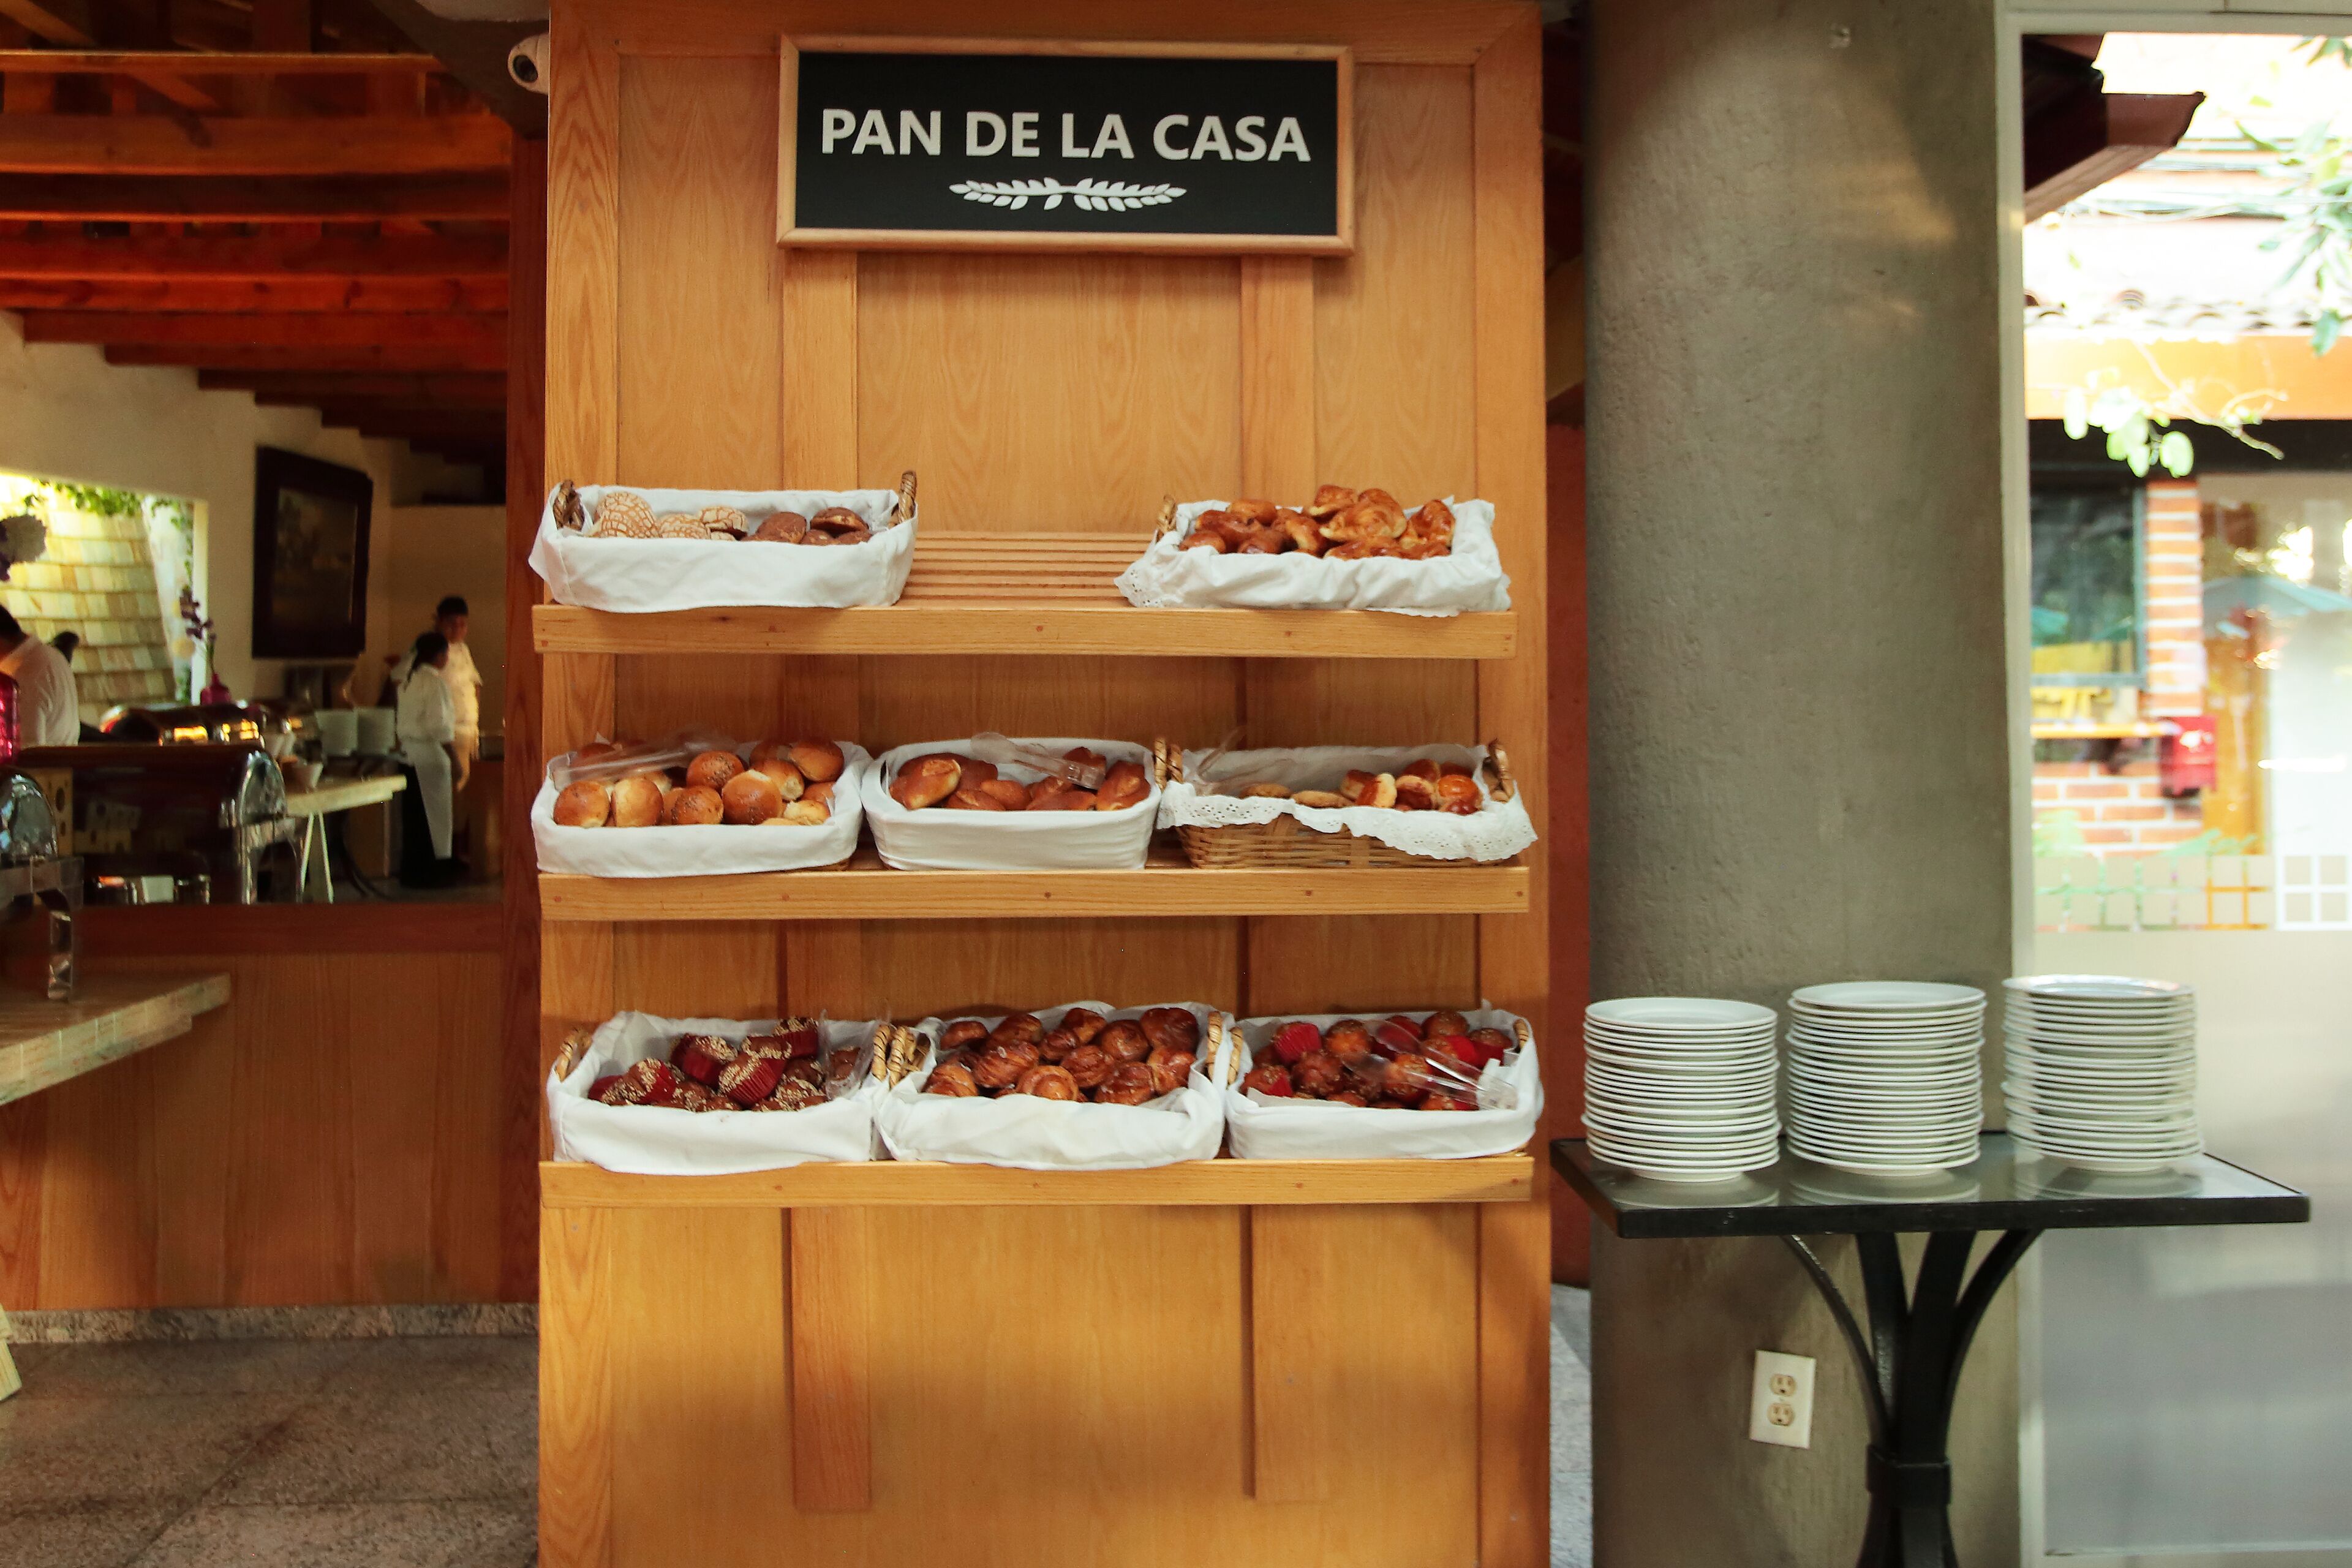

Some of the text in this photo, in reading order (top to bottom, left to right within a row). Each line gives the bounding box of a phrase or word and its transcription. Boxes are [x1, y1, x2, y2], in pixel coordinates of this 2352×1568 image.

[822, 109, 1311, 162] PAN DE LA CASA
